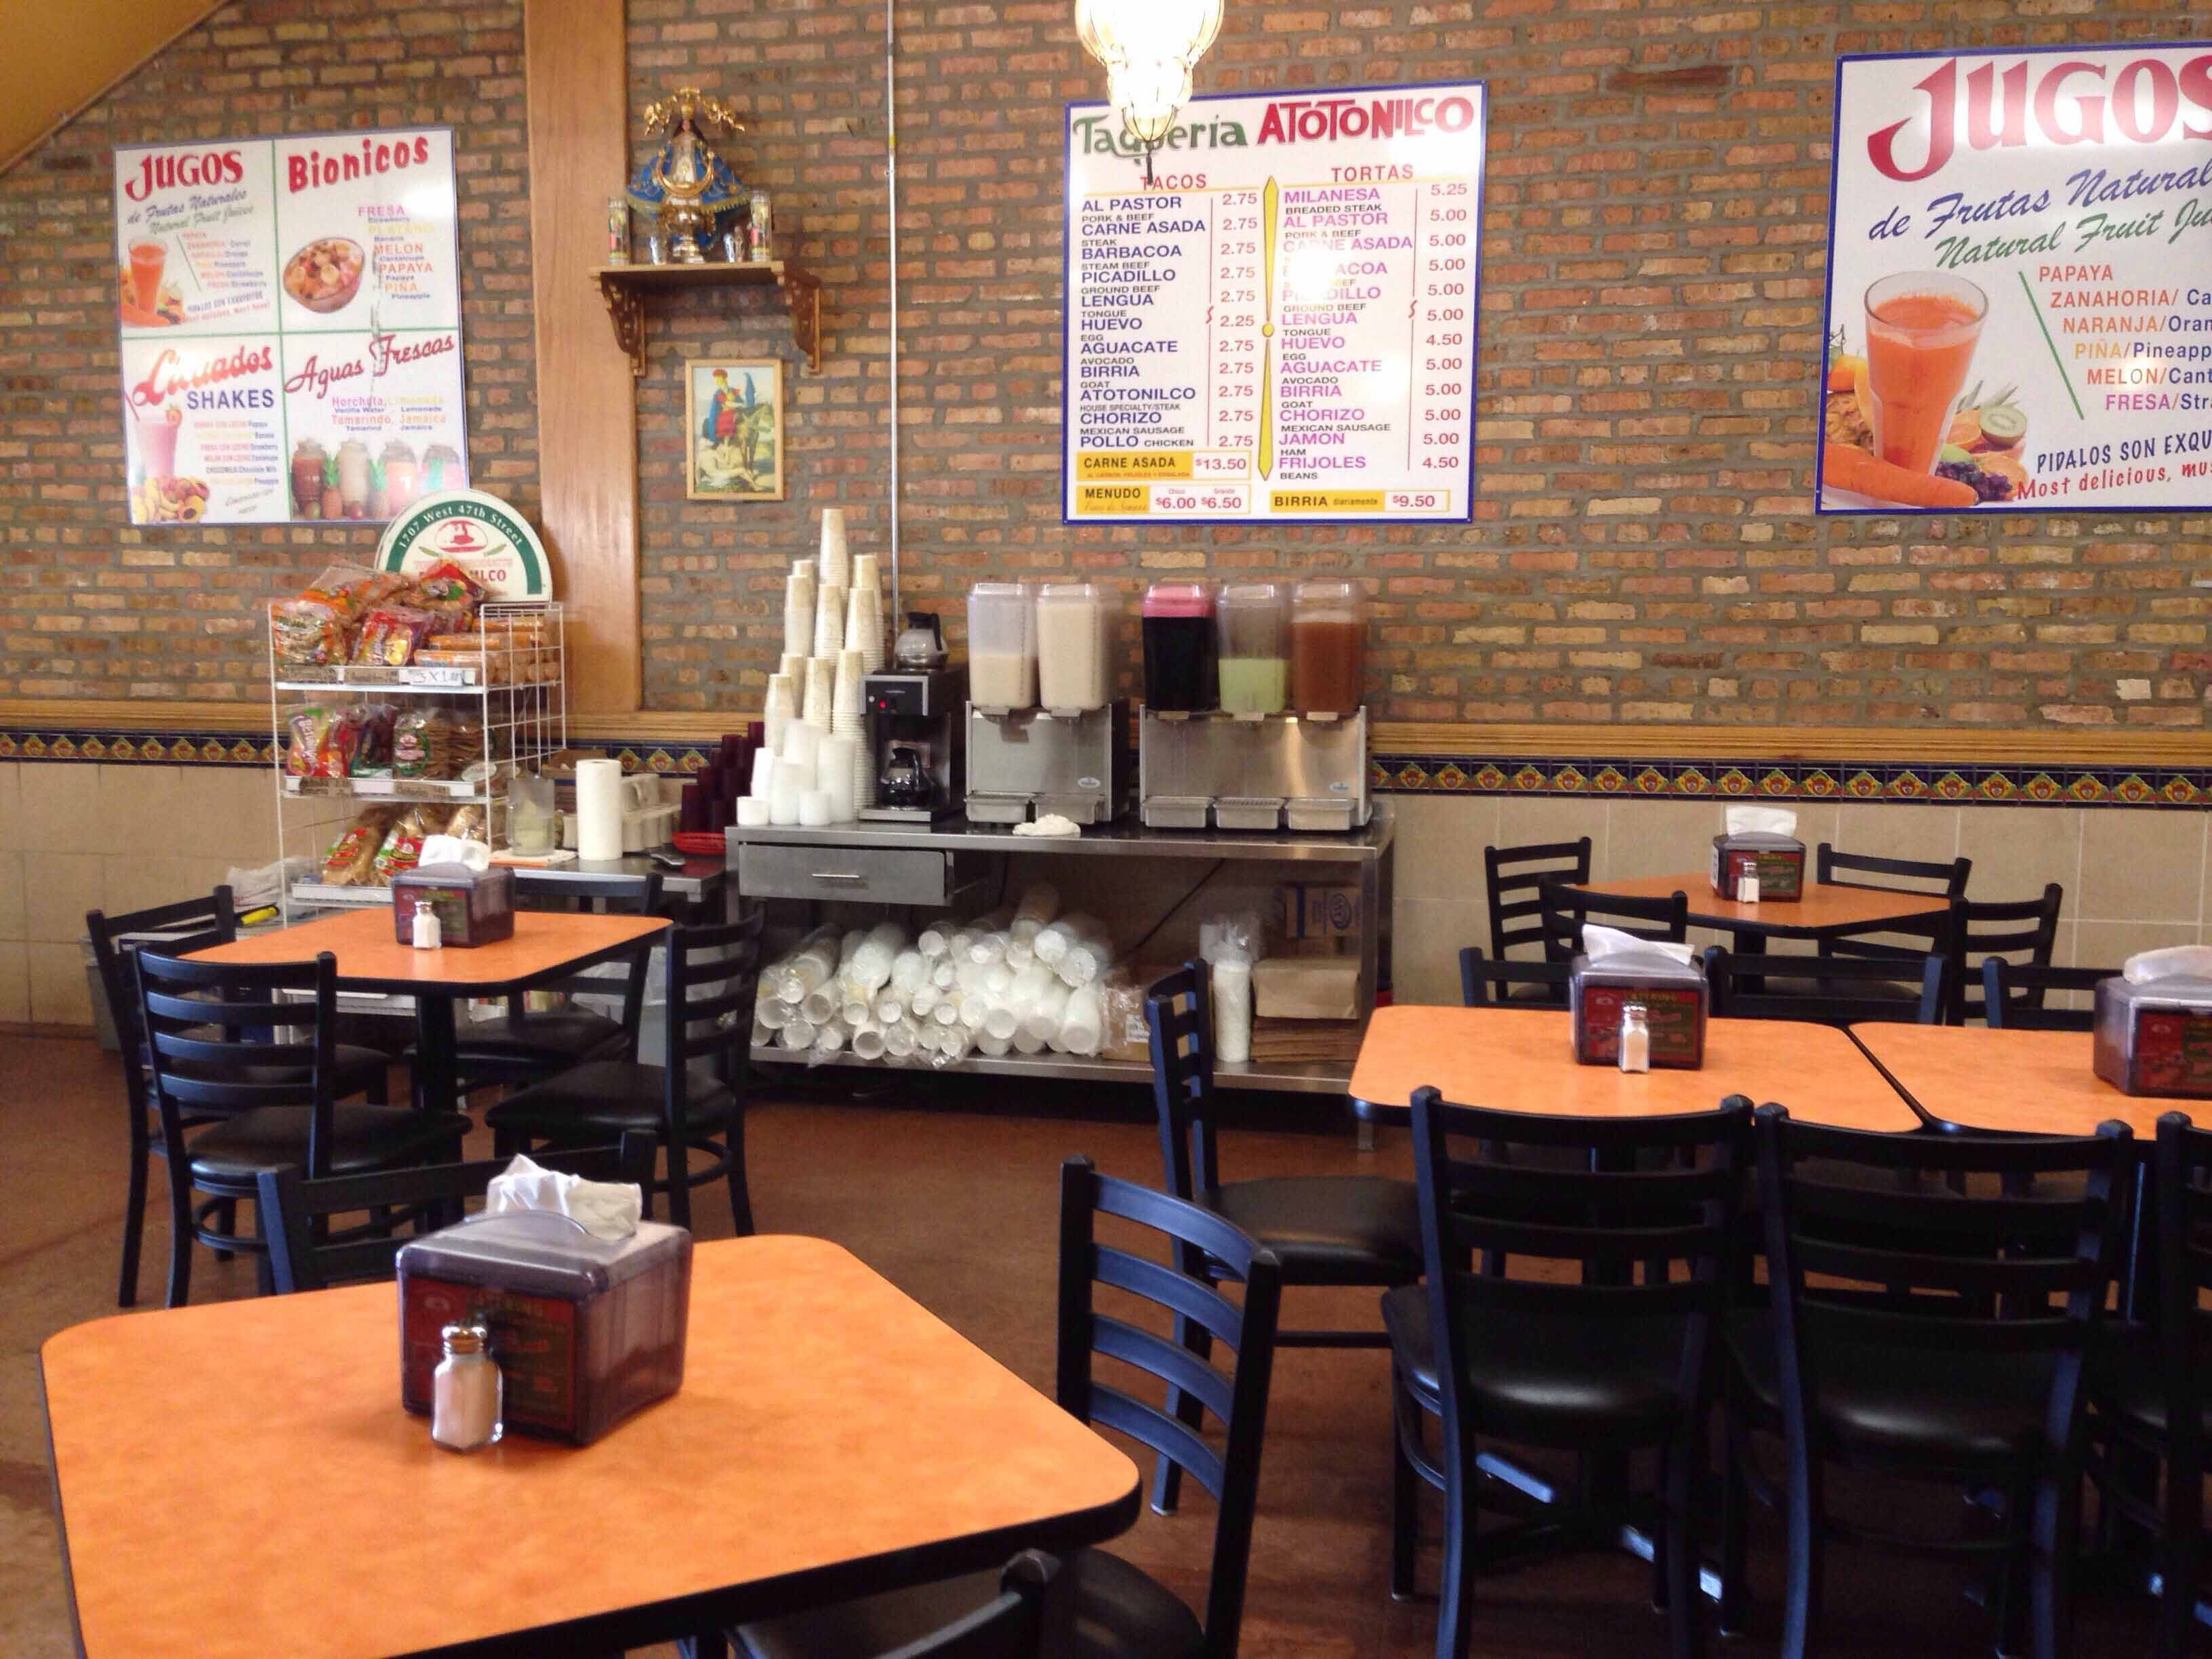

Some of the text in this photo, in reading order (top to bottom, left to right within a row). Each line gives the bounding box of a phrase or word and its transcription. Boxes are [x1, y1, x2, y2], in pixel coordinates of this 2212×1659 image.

[1257, 97, 1474, 144] ATOTONILCO
[1866, 55, 2212, 182] JUGOS
[288, 137, 428, 193] Bionicos
[1331, 164, 1413, 182] TORTAS
[125, 150, 243, 201] JUGOS
[1141, 173, 1206, 190] TACOS
[1285, 184, 1467, 203] MILANESA 5.25
[1082, 192, 1257, 212] AL PASTOR 2.75
[1286, 206, 1340, 214] BREADED
[358, 205, 405, 216] FRESA
[1284, 209, 1467, 228] AL PASTOR 5.00
[1868, 207, 1910, 241] de
[1926, 189, 2051, 239] Frutas
[1082, 218, 1257, 236] CARNE ASADA 2.75
[1351, 237, 1412, 249] ASADA
[1429, 234, 1465, 246] 5.00
[1934, 222, 2068, 268] Natural
[2074, 210, 2164, 253] Fruit
[1082, 243, 1255, 260] BARBACOA 2.75
[380, 263, 434, 272] PAPAYA
[1429, 259, 1465, 271] 5.00
[2039, 265, 2113, 281] PAPAYA
[1082, 268, 1255, 283] PICADILLO 2.75
[1427, 283, 1464, 295] 5.00
[1082, 290, 1255, 306] LENGUA 2.75
[1082, 316, 1254, 330] HUEVO 2.25
[1282, 309, 1463, 325] LENGUA 5.00
[1080, 340, 1254, 354] AGUACATE 2.75
[1281, 333, 1462, 349] HUEVO 4.50
[283, 335, 454, 398] Aguas Frescas
[1082, 363, 1253, 377] BIRRIA 2.75
[1281, 359, 1462, 374] AGUACATE 5.00
[1080, 386, 1253, 401] ATOTONILCO 2.75
[1281, 384, 1461, 397] BIRRIA 5.00
[187, 389, 274, 409] SHAKES
[1080, 411, 1253, 424] CHORIZO 2.75
[1280, 409, 1460, 421] CHORIZO 5.00
[1080, 436, 1139, 447] POLLO
[1219, 436, 1252, 447] 2.75
[1279, 433, 1458, 445] JAMON 5.00
[1084, 457, 1246, 469] CARNE ASADA $13.50
[1279, 457, 1458, 468] FRIJOLES 4.50
[2037, 445, 2110, 473] PIDALOS
[2120, 438, 2155, 460] SON
[2018, 477, 2070, 499] Most
[2079, 467, 2171, 491] delicious,
[1086, 489, 1141, 498] MENUDO
[1155, 497, 1195, 508] $6.00
[1201, 497, 1242, 508] $6.50
[1274, 495, 1435, 507] BIRRIA diariamente $9.50
[423, 507, 453, 523] West
[458, 505, 486, 519] 47th
[490, 514, 523, 546] Street
